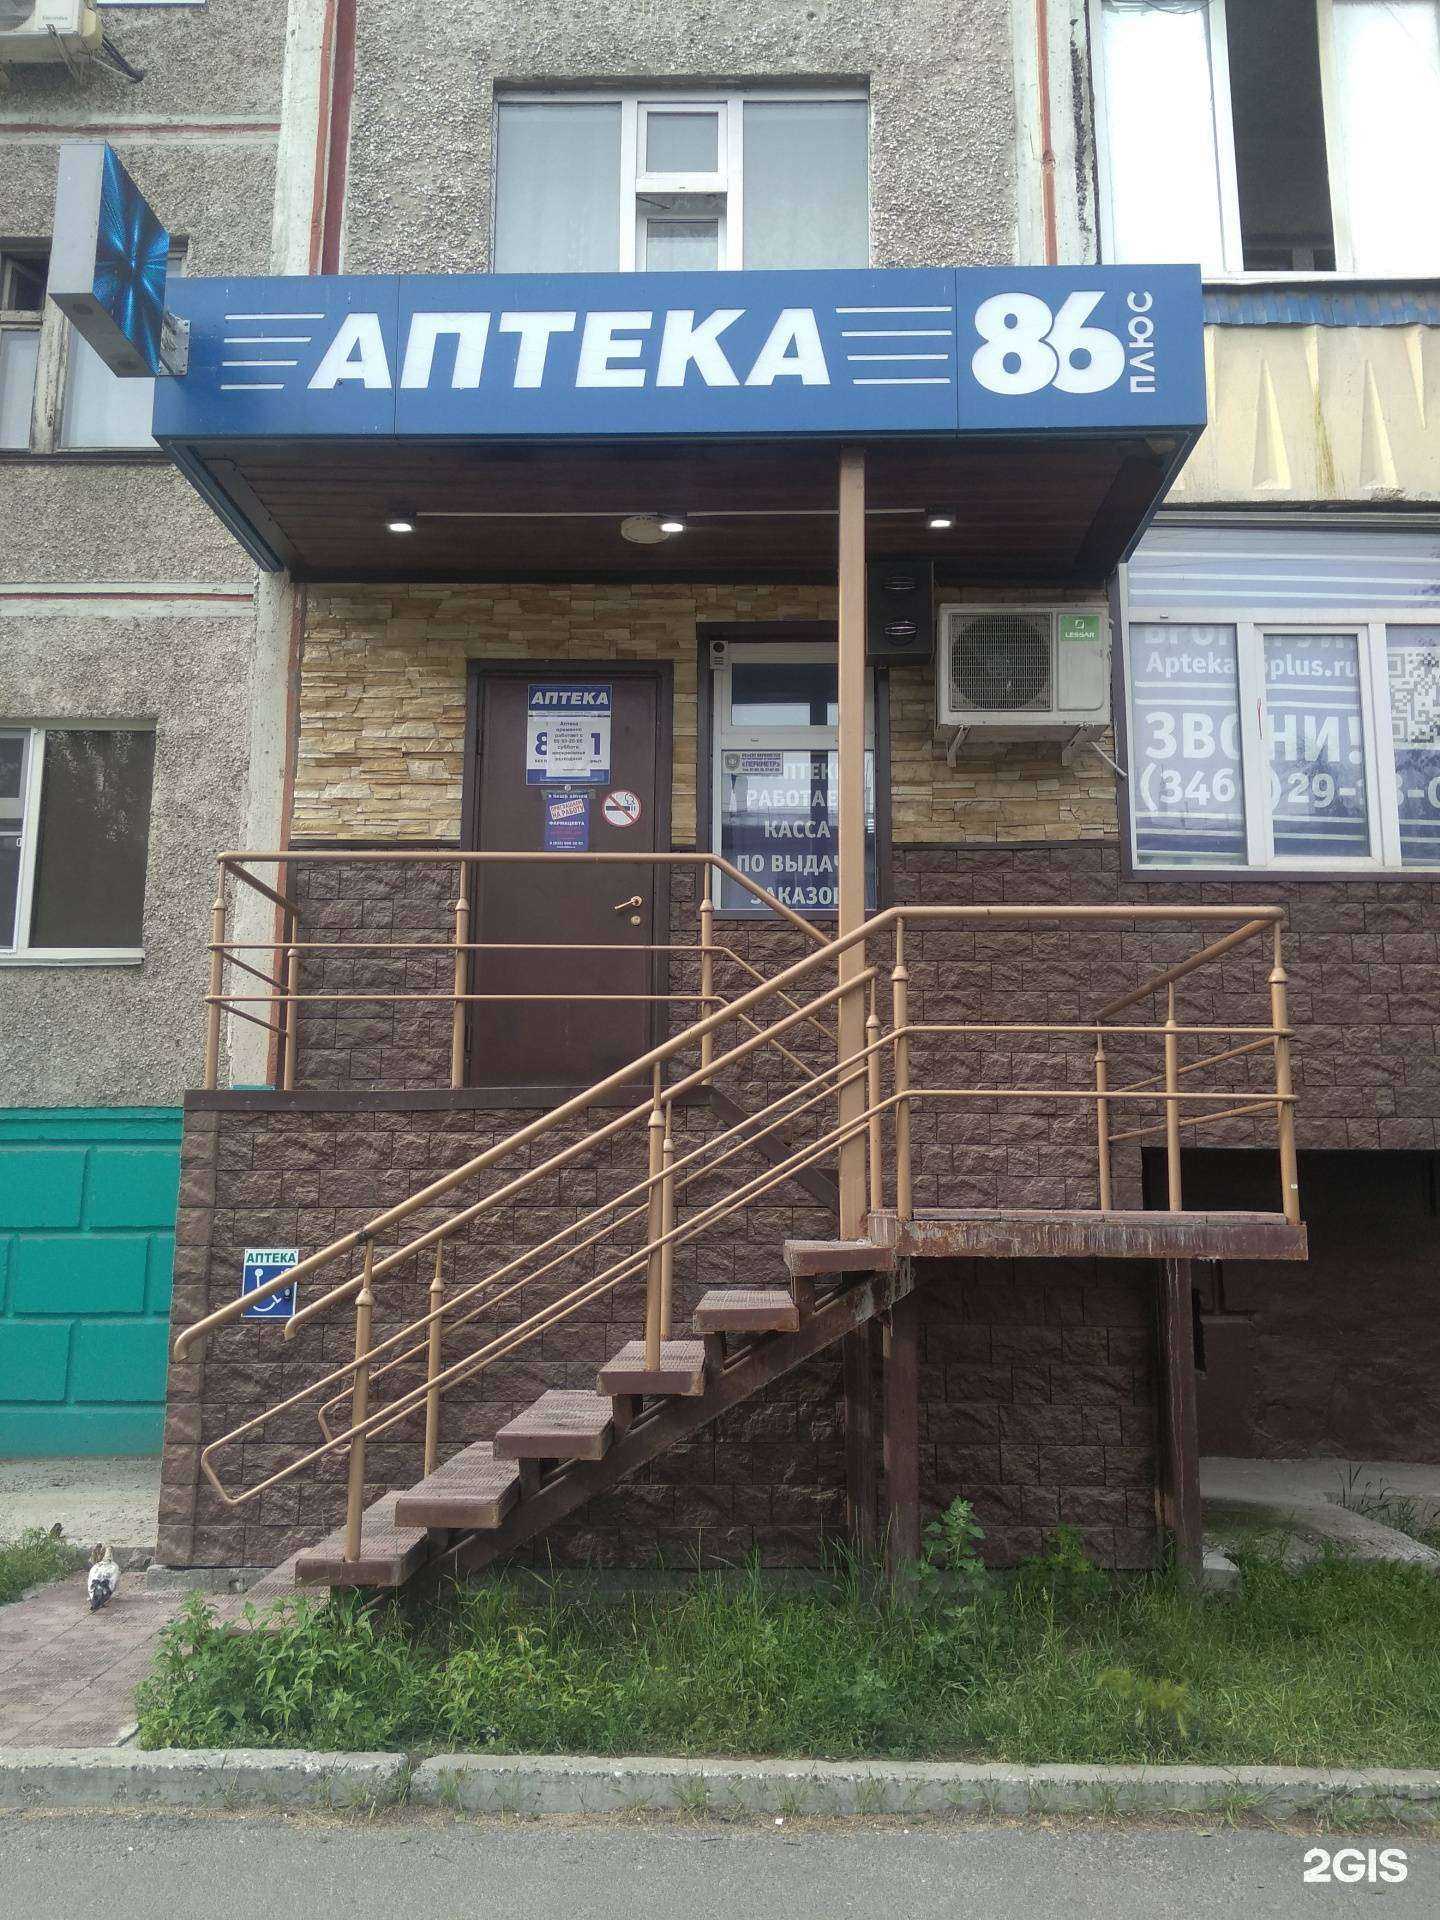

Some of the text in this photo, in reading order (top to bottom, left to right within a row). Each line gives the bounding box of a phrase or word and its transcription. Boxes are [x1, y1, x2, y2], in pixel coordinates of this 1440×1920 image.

[307, 306, 832, 390] АПТЕКА
[971, 290, 1126, 395] 86
[1126, 290, 1156, 393] ПЛЮС
[531, 691, 609, 705] АПТЕКА
[747, 789, 839, 807] РАБОТАЕ
[764, 820, 831, 838] КАССА
[737, 854, 765, 872] ПО
[246, 1252, 296, 1263] АПТЕКА
